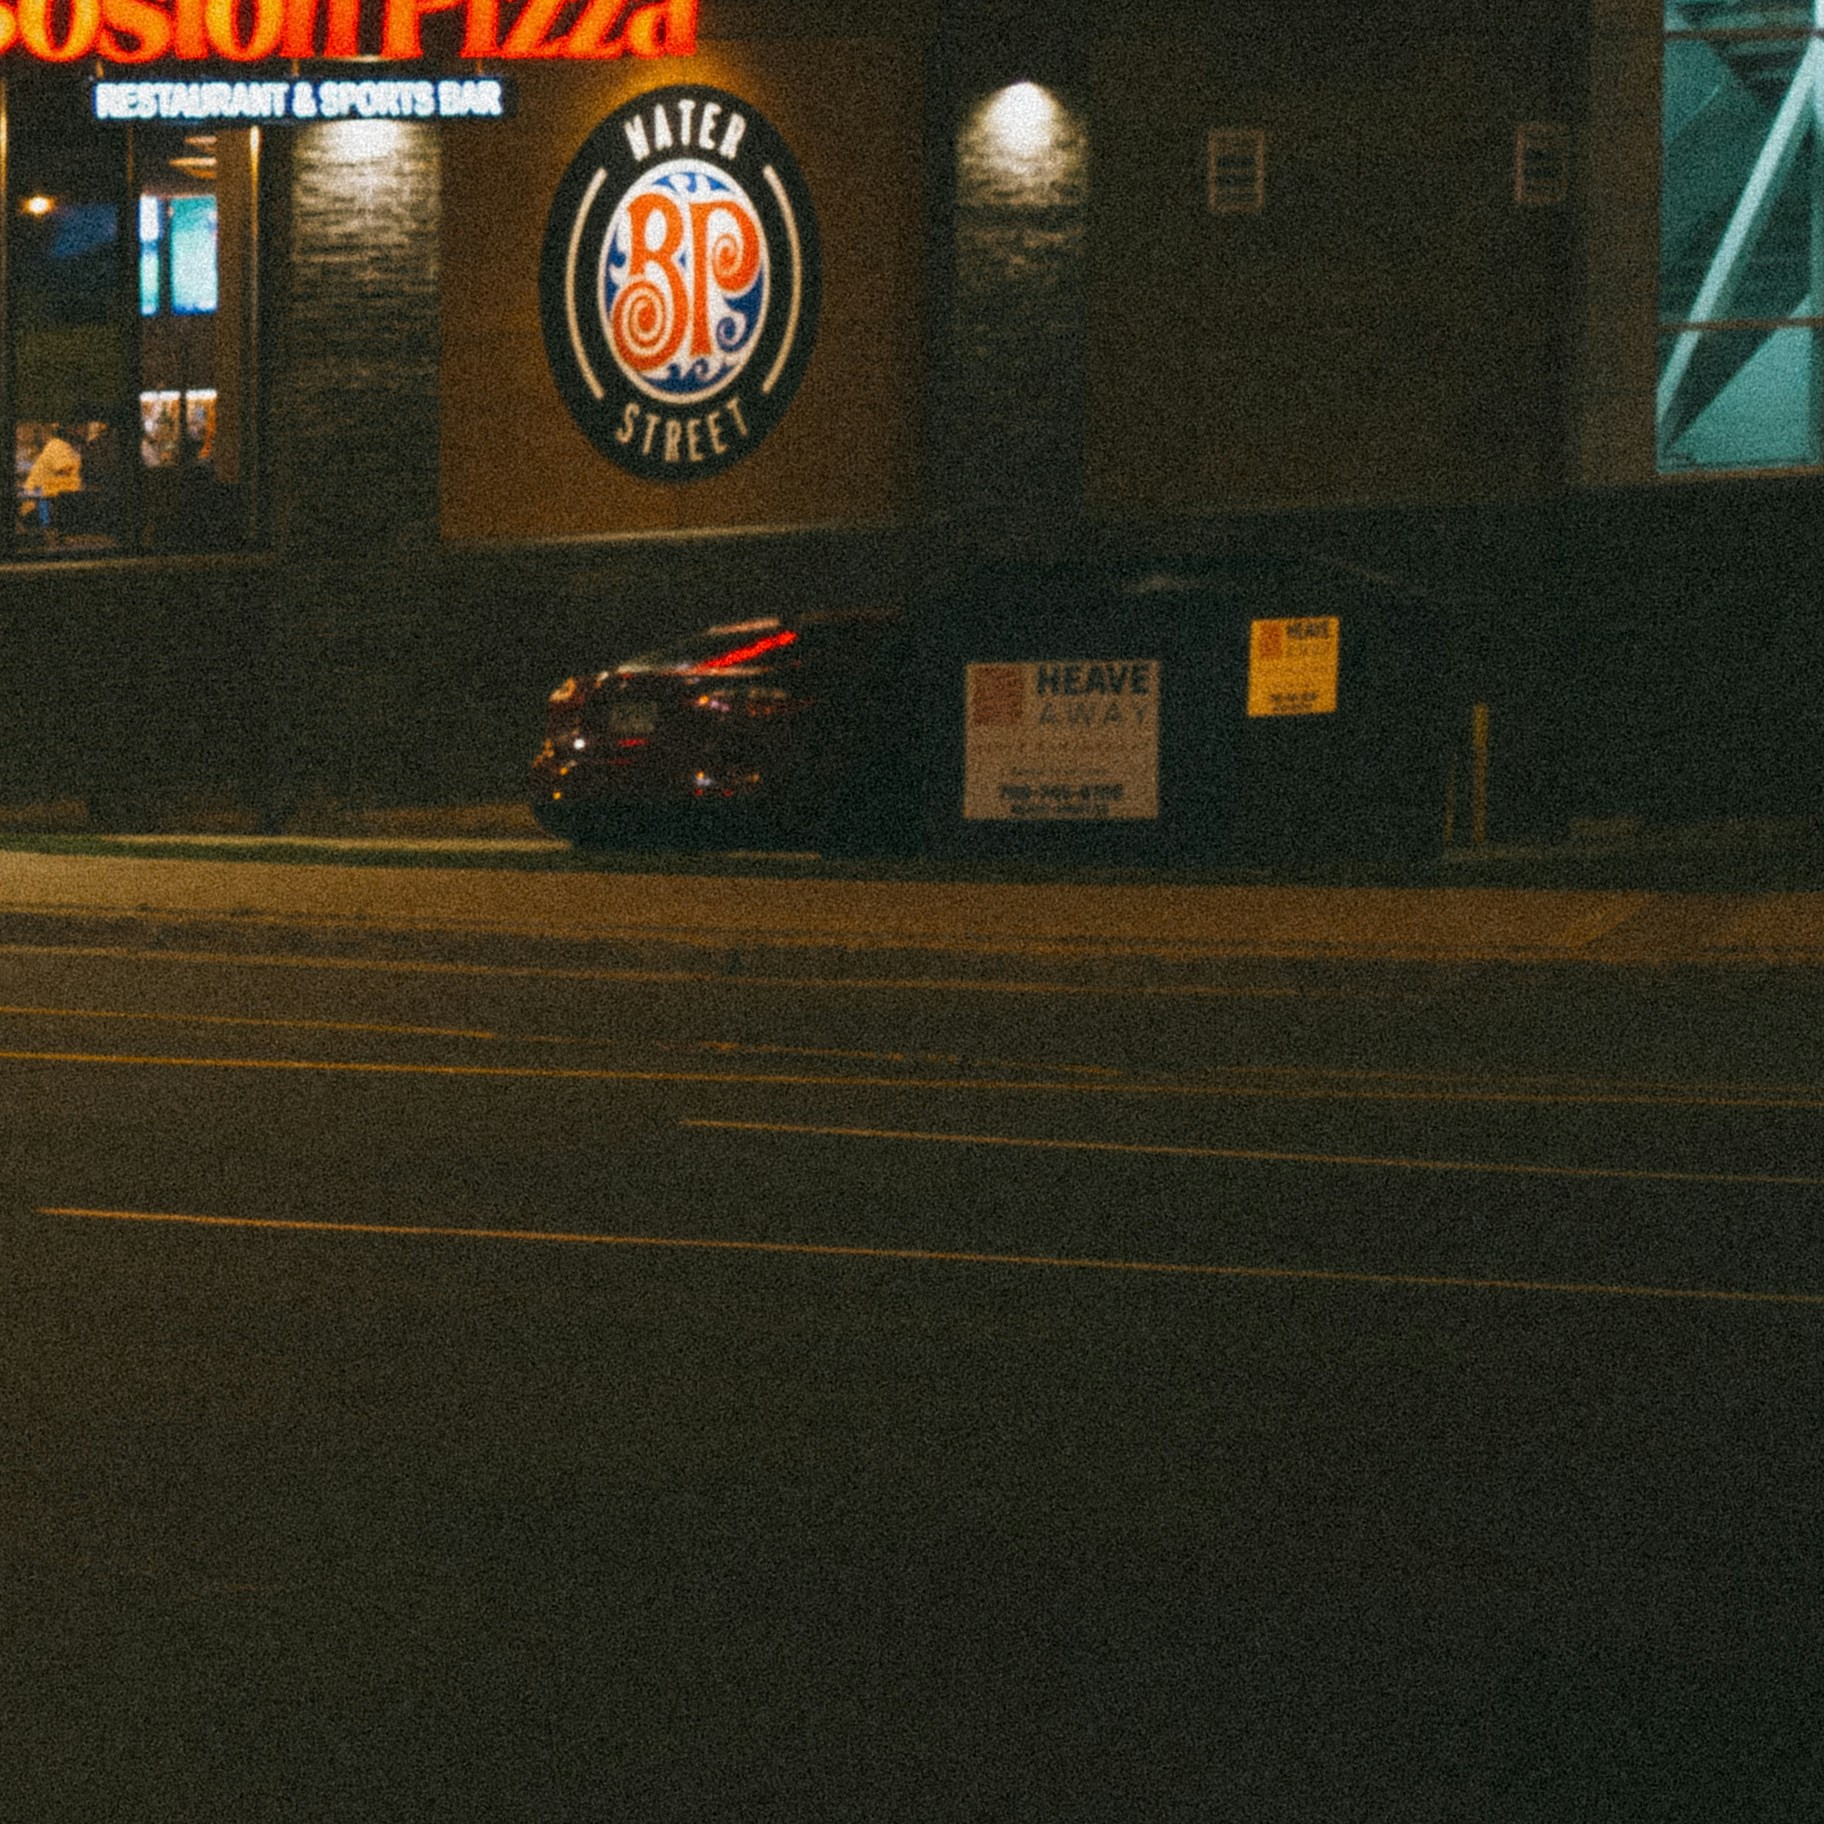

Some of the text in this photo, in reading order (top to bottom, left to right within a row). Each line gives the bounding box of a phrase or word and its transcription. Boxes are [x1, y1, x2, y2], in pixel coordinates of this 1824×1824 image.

[95, 81, 502, 119] RESTAURANT & SPORTS BAR
[623, 99, 747, 161] WATER
[616, 397, 749, 463] STREET
[1037, 663, 1150, 695] HEAVE
[1039, 701, 1150, 725] AWAY
